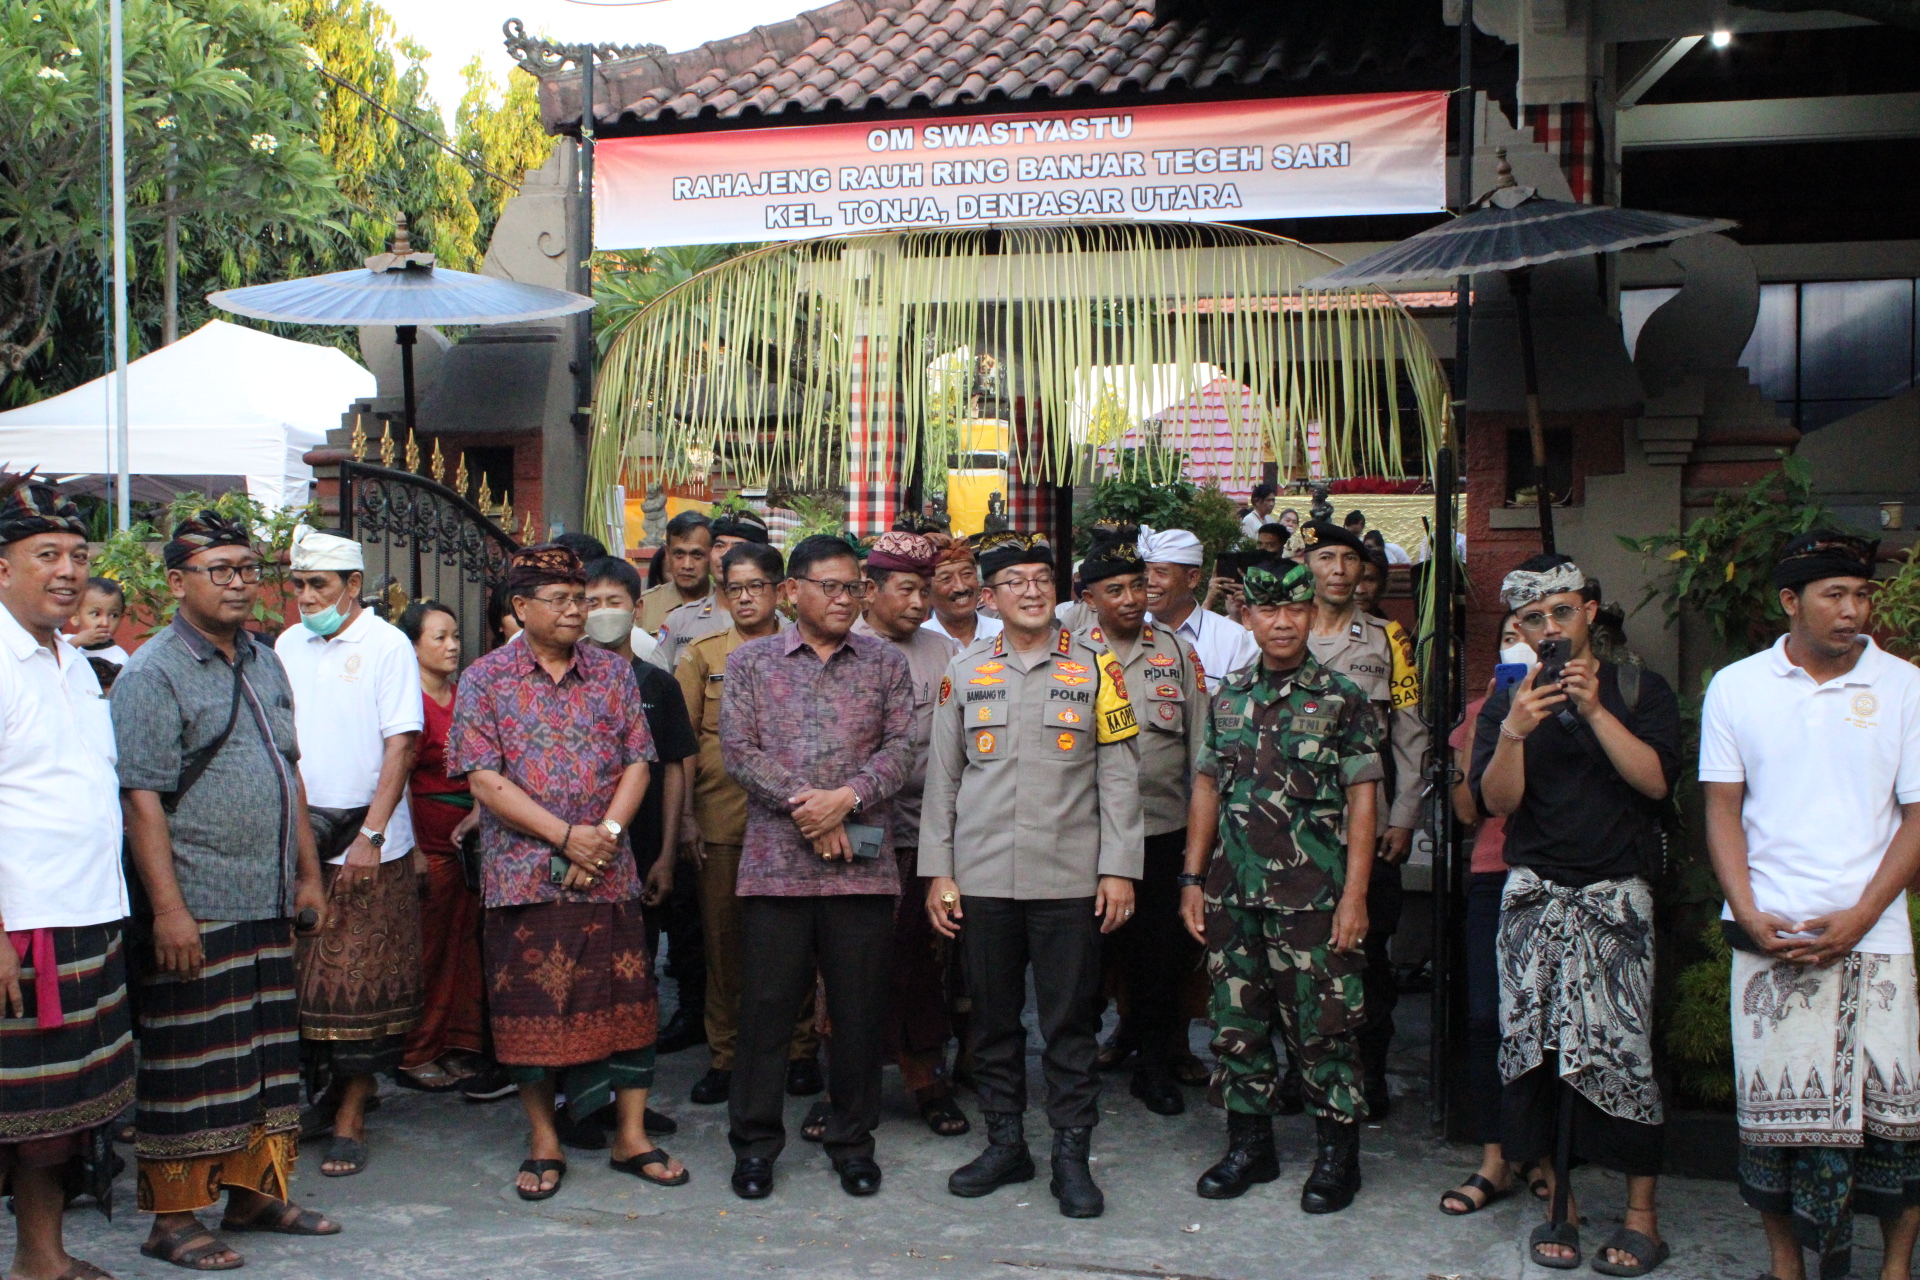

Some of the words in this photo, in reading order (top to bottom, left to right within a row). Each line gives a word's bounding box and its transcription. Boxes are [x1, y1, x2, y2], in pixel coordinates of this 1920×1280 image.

[867, 127, 914, 152] OM
[923, 114, 1133, 149] SWASTYASTU
[672, 168, 831, 200] RAHAJENG
[839, 163, 923, 191] RAUH
[932, 158, 1009, 186] RING
[1017, 151, 1145, 182] BANJAR
[1152, 145, 1263, 175] TEGEH
[1271, 141, 1350, 170] SARI
[765, 203, 832, 230] KEL.
[838, 197, 949, 226] TONJA,
[957, 187, 1125, 220] DENPASAR
[1131, 183, 1243, 212] UTARA
[1144, 668, 1180, 680] POLRI
[1349, 664, 1385, 675] POLRI
[966, 689, 997, 702] BAMBANG
[1050, 688, 1090, 703] POLRI
[1106, 712, 1122, 732] KA
[1299, 718, 1320, 731] TNI
